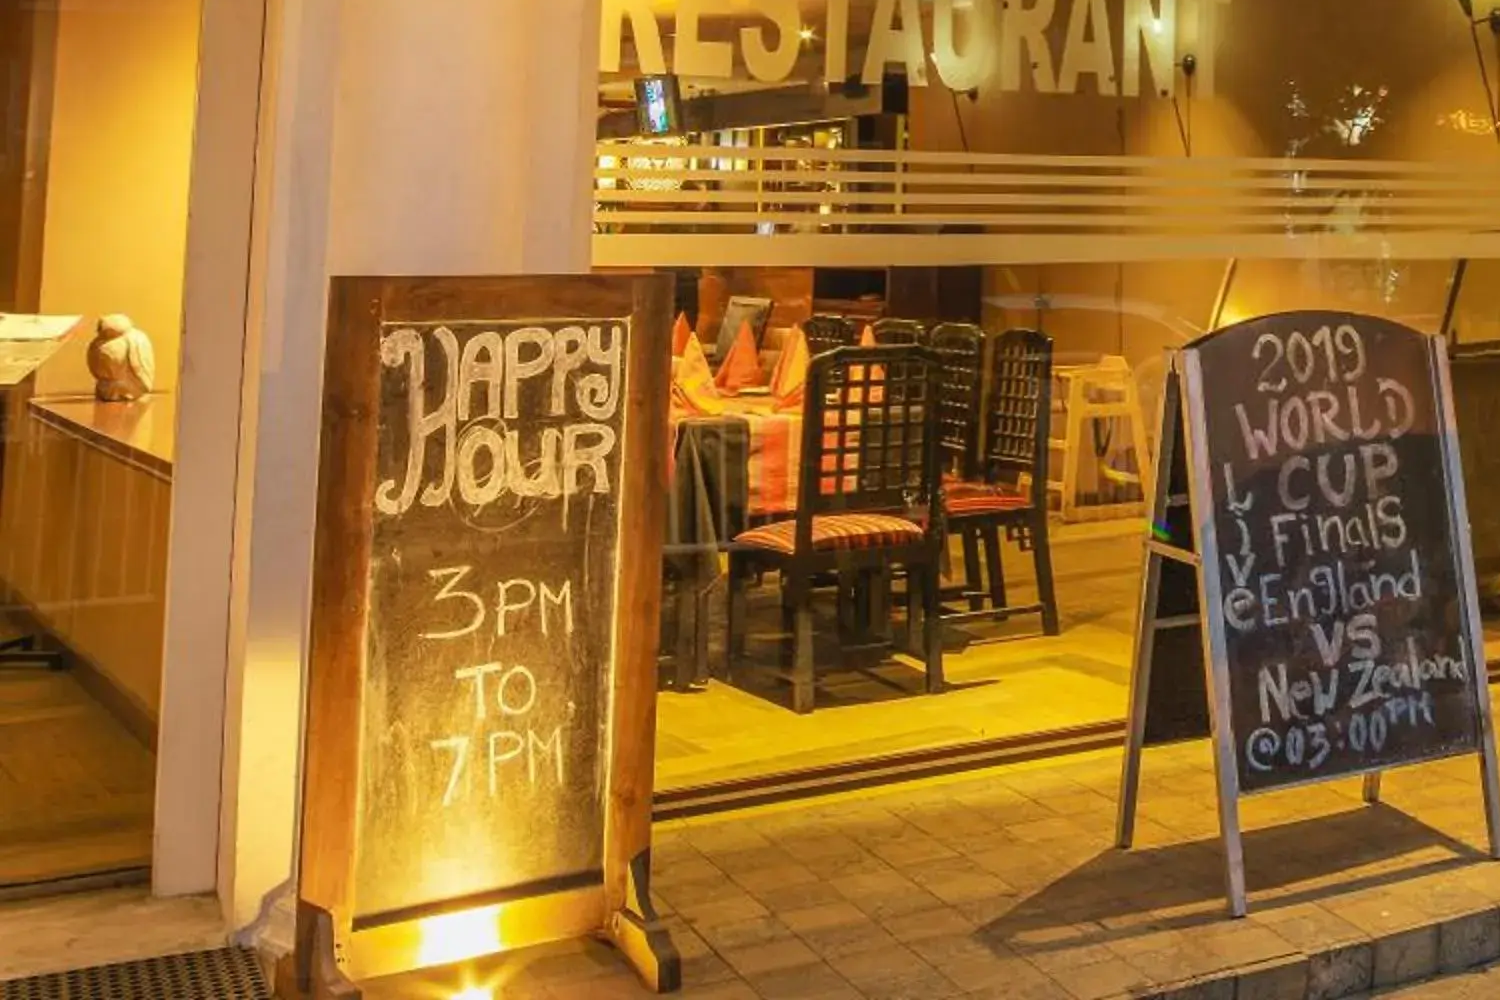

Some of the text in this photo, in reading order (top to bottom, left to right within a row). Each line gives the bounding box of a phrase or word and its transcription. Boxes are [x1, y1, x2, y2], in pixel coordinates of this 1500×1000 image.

[1252, 325, 1367, 392] 2019
[1234, 378, 1416, 460] WORLD
[1278, 442, 1398, 511] CUP
[418, 565, 574, 639] 3 PM
[1259, 549, 1422, 627] England
[455, 662, 537, 720] TO
[1347, 634, 1468, 709] Zealand
[430, 727, 563, 807] 7 PM
